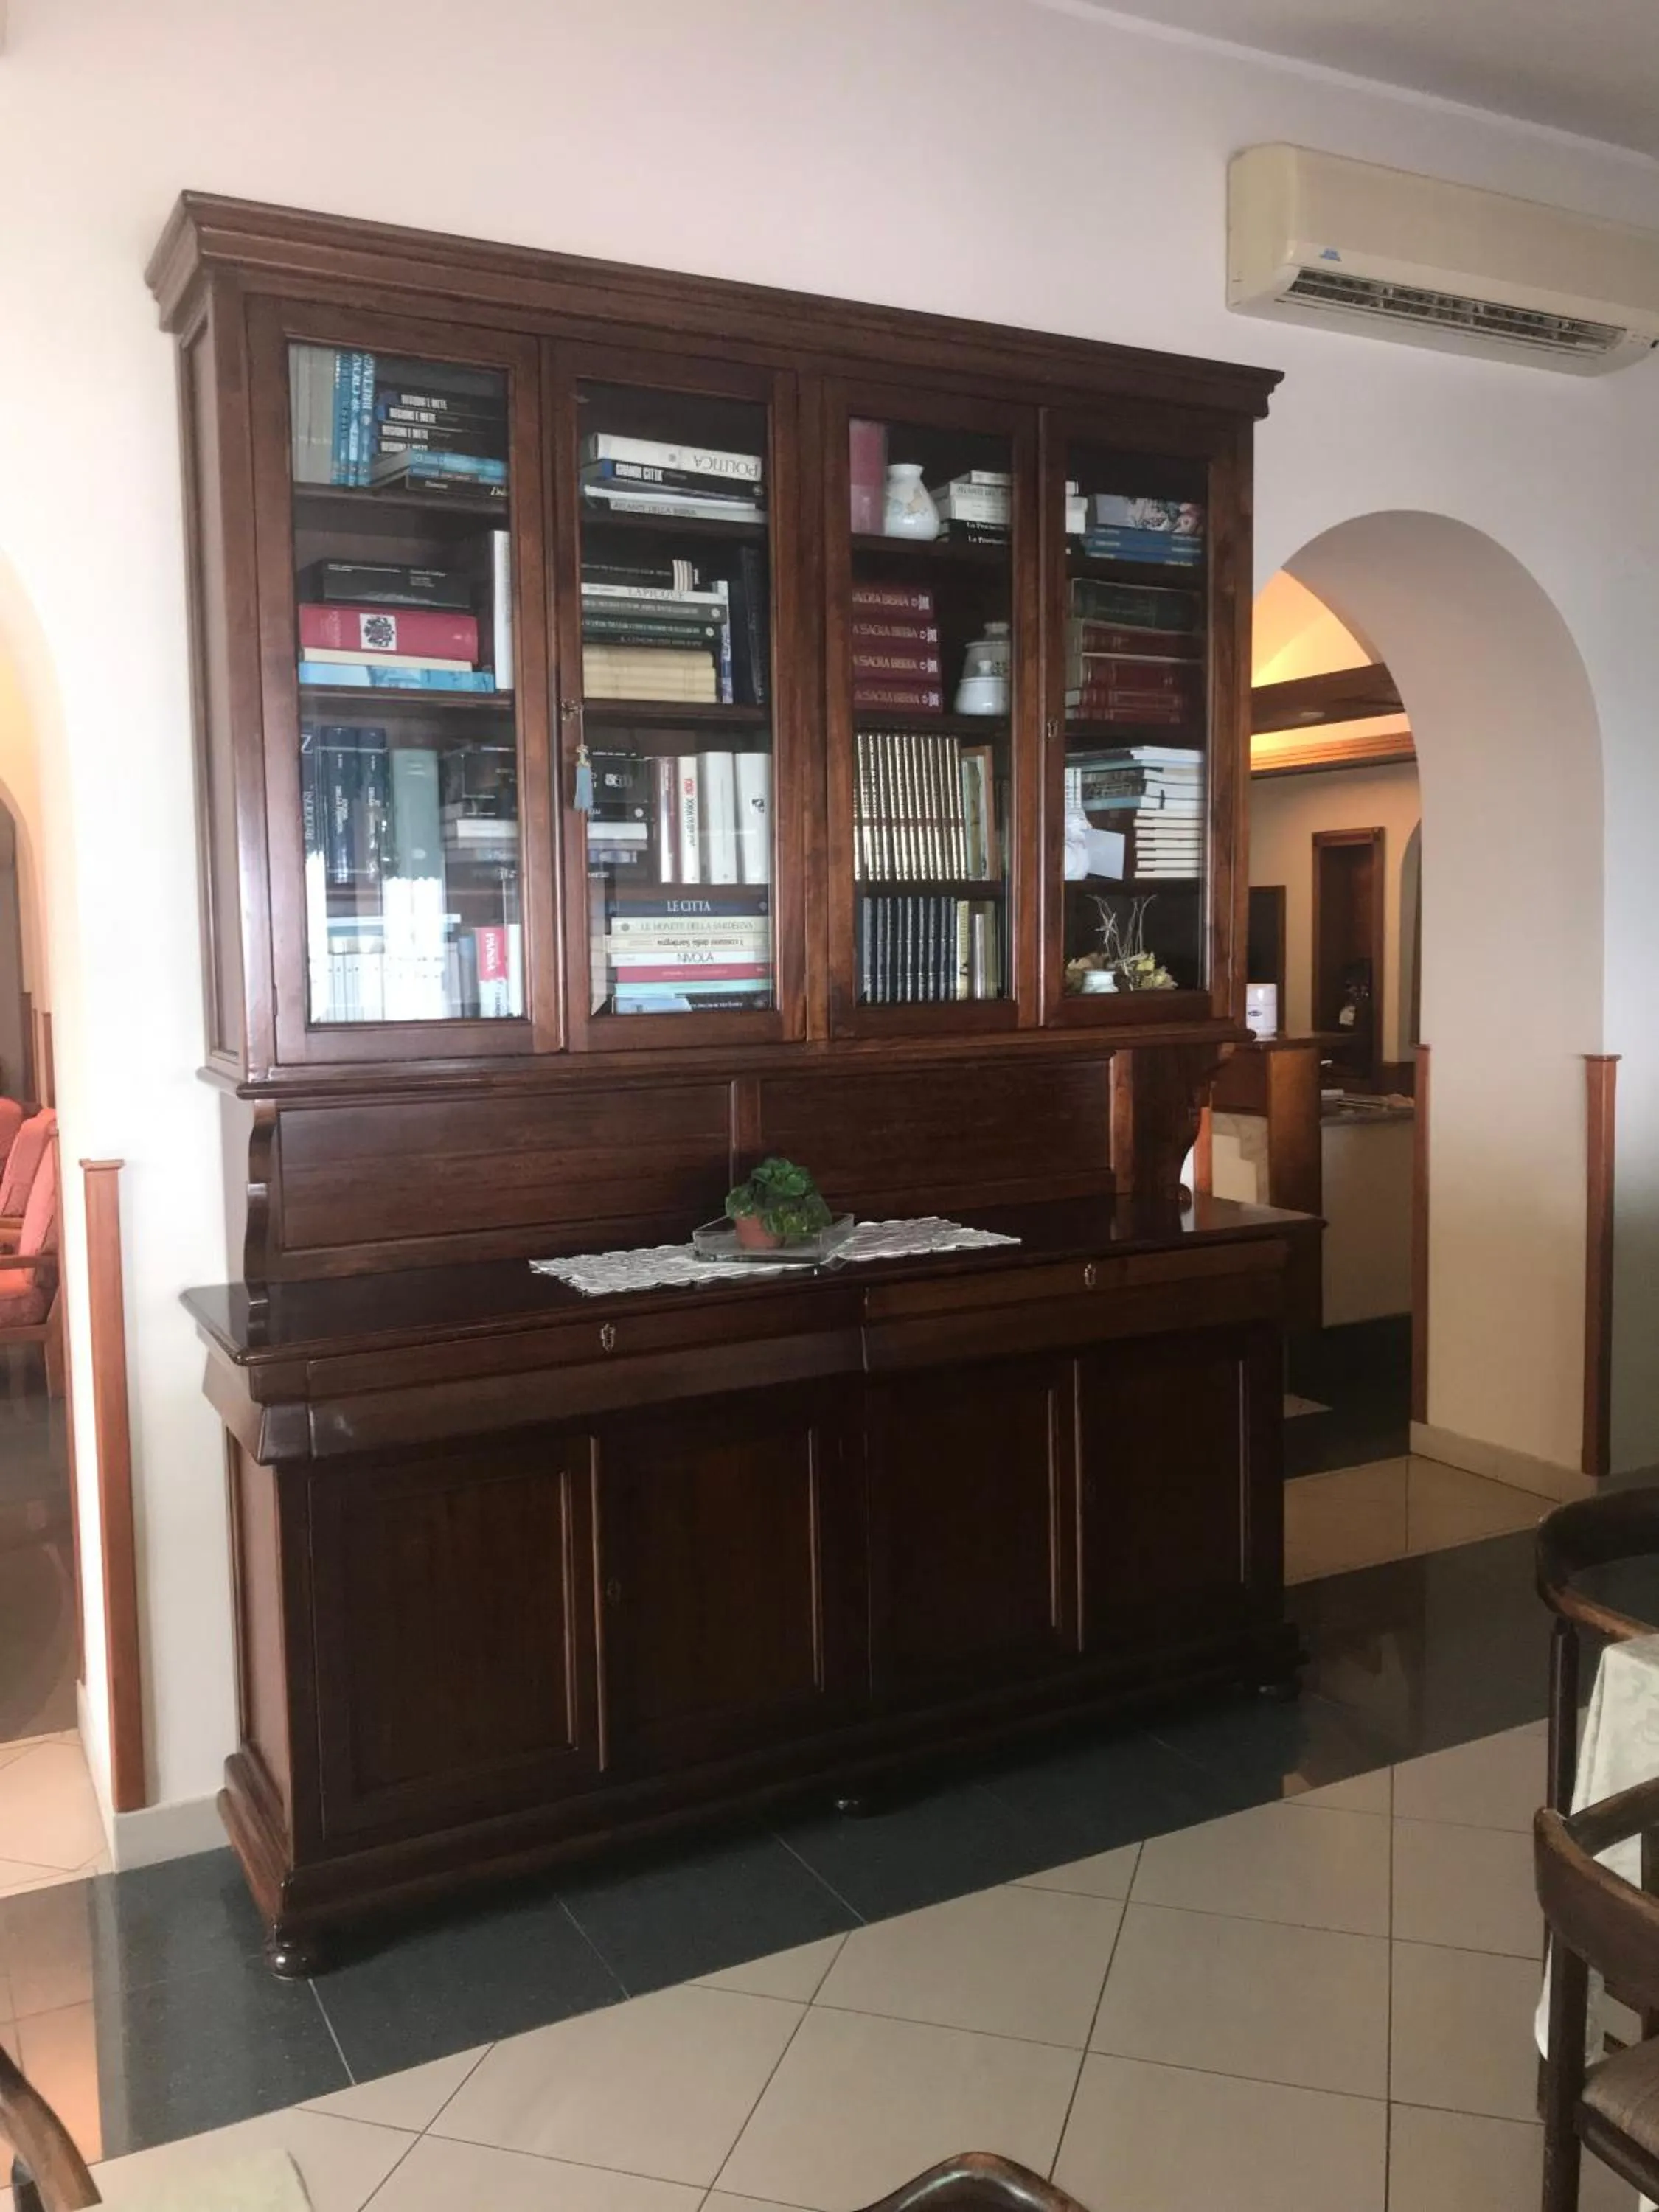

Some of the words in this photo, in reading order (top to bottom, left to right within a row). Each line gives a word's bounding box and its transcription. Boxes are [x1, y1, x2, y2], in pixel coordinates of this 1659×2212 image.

[693, 455, 758, 479] POLITICA
[860, 624, 891, 636] SACRA
[891, 626, 918, 639] BIBBIA
[859, 655, 890, 668] SACRA
[890, 658, 917, 670] BIBBIA
[861, 689, 893, 703] SACRA
[893, 692, 919, 705] BIBBIA
[667, 900, 680, 912] LE
[640, 922, 650, 931] LE
[686, 921, 712, 931] DELLA
[712, 920, 754, 931] SARDEGNA
[484, 933, 498, 972] PANSA
[677, 951, 714, 963] NIVOLA
